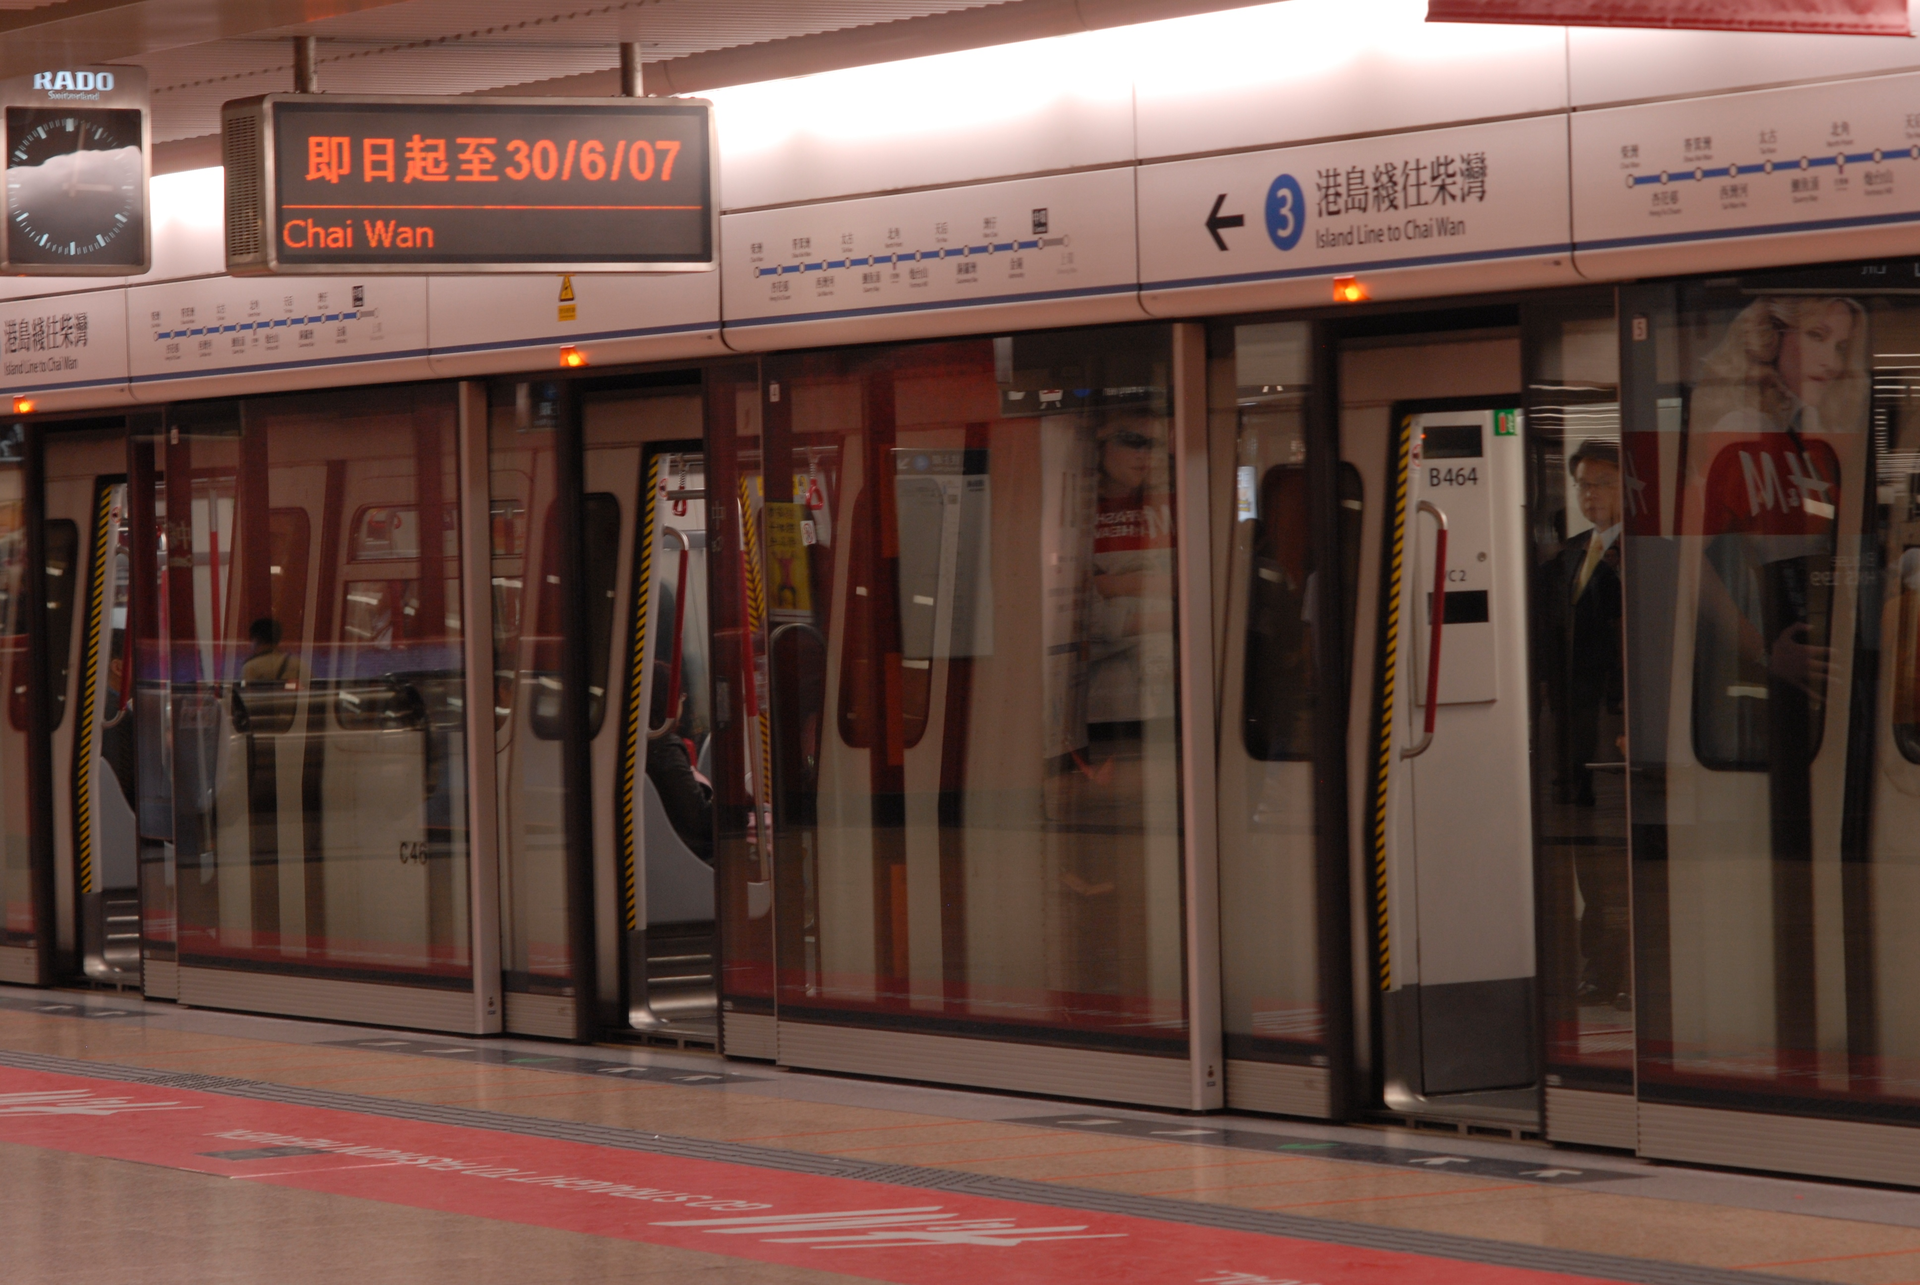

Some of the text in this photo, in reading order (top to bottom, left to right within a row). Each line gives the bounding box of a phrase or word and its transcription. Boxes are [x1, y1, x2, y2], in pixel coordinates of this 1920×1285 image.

[33, 71, 114, 91] RADO
[305, 134, 681, 184] 即日起至30/6/07
[1276, 187, 1296, 238] 3
[283, 219, 434, 249] Chai Wan
[1315, 216, 1466, 249] Island Line to Chai Wan
[1429, 467, 1479, 488] B464
